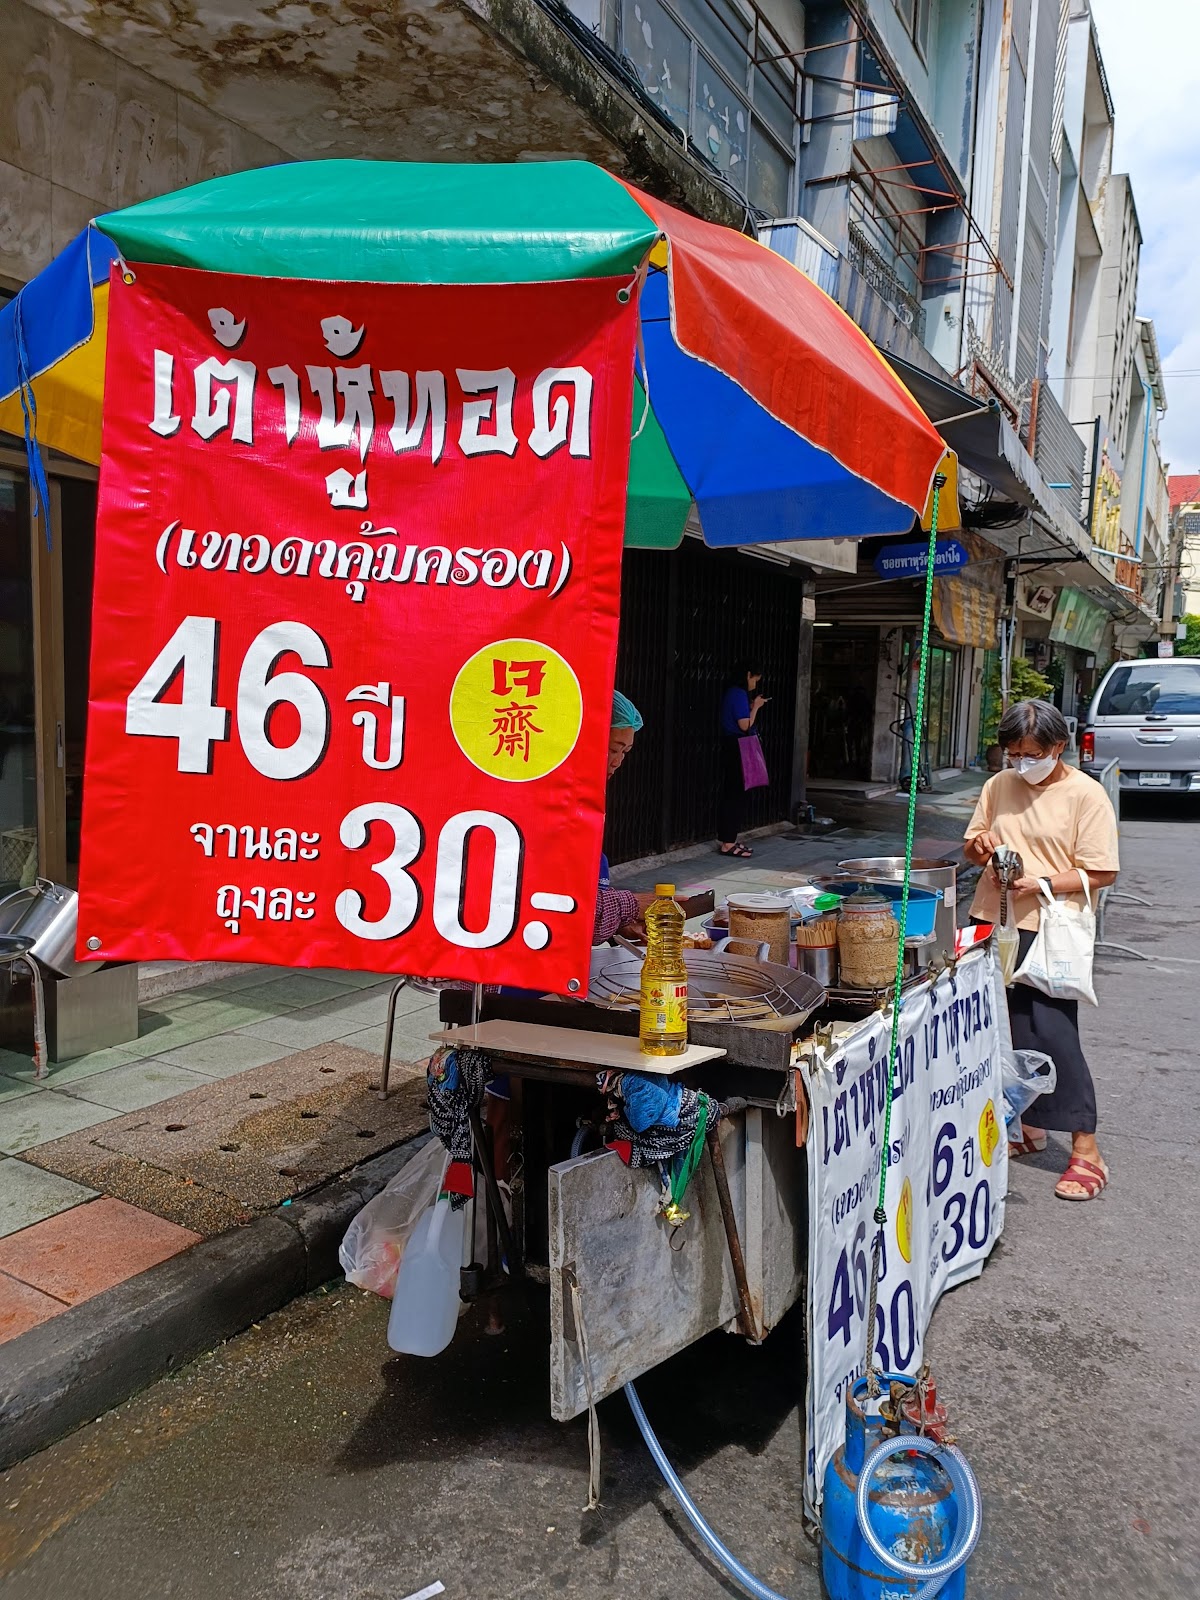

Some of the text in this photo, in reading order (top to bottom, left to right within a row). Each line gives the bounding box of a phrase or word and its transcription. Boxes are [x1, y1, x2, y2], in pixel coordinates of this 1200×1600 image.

[148, 307, 594, 509] เต้าหู้ทอด
[154, 520, 572, 602] (เทวดาคุ้มครอง)
[125, 615, 406, 781] 46 ปี
[490, 658, 548, 698] เจ
[188, 821, 321, 862] จานละ
[334, 801, 577, 951] 30.-
[215, 882, 316, 934] ถุงละ
[927, 1122, 957, 1208] 6
[961, 1136, 975, 1178] ปี
[828, 1220, 867, 1348] 46
